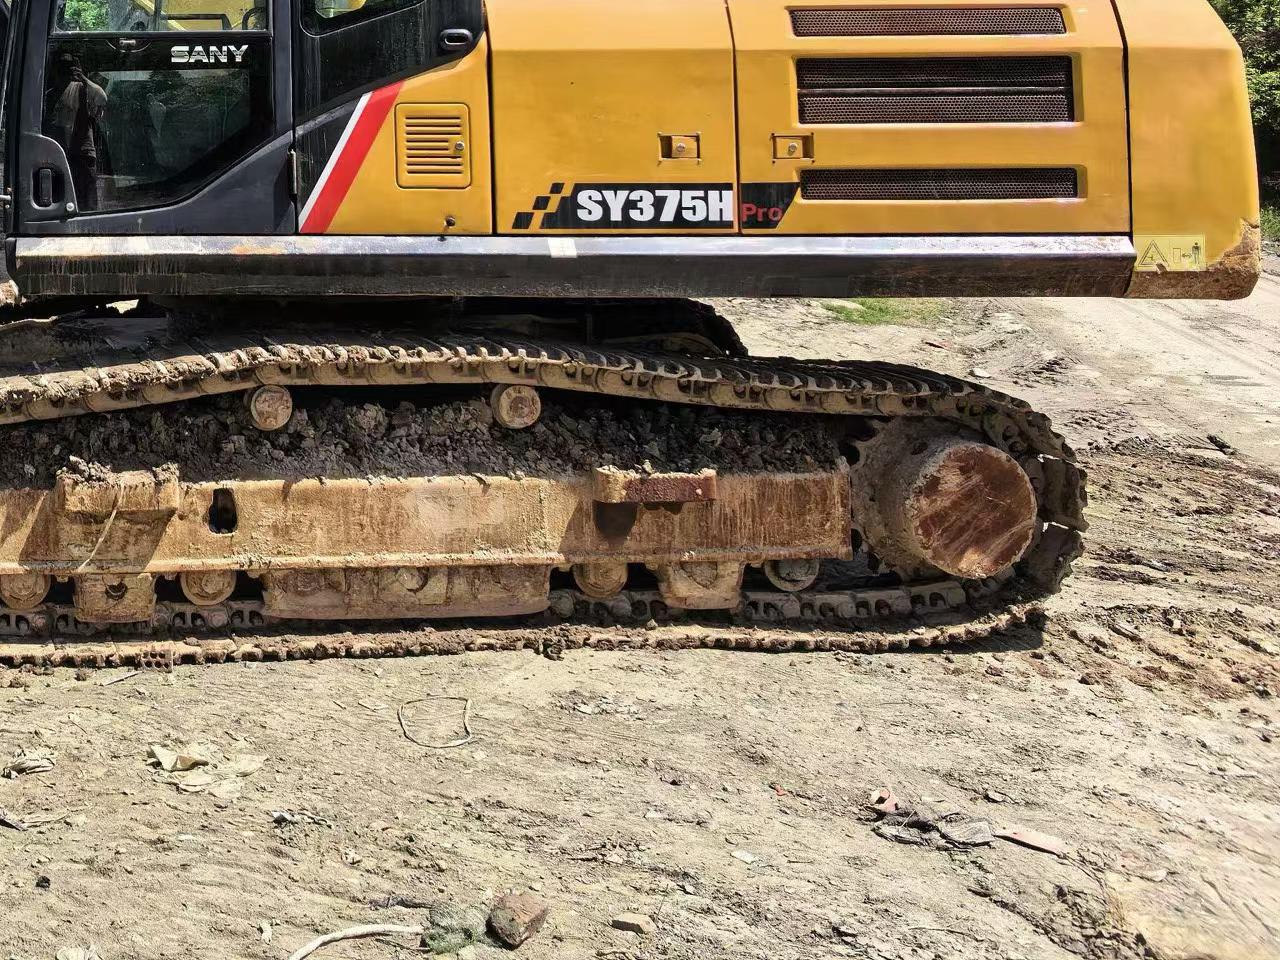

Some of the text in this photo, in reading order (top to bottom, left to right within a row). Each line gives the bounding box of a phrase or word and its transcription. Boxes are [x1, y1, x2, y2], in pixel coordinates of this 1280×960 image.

[170, 45, 249, 63] SANY
[576, 189, 783, 222] SY375H Pro
